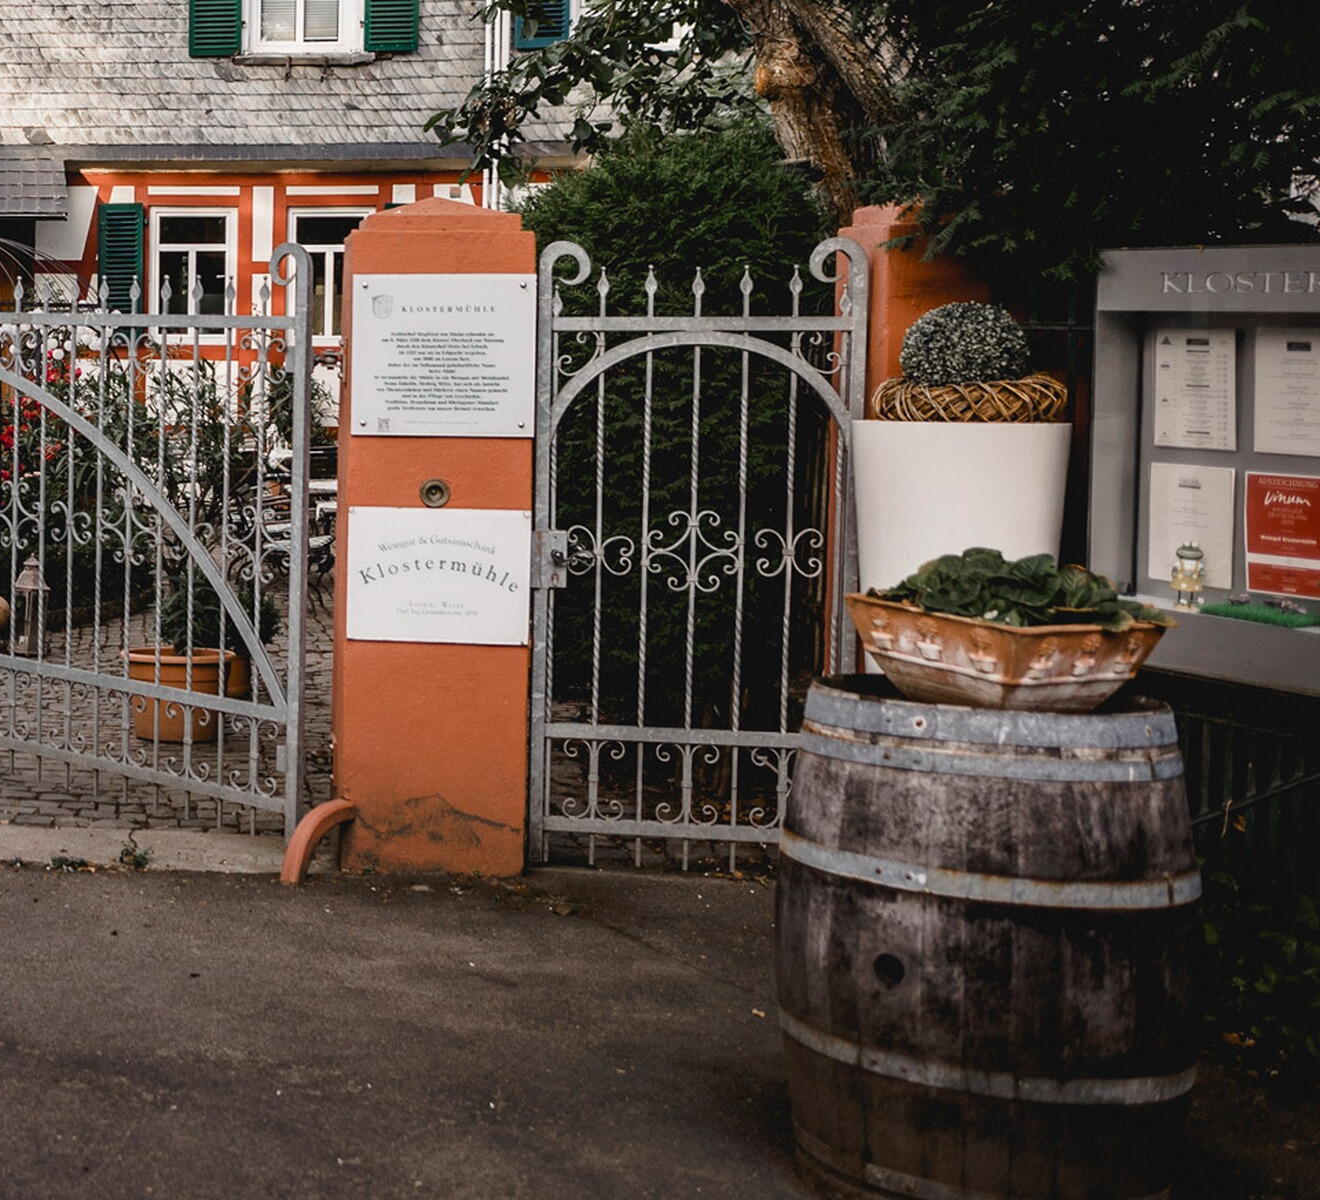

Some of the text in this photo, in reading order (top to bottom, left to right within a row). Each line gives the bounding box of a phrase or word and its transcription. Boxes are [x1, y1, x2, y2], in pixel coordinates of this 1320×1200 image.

[401, 305, 496, 313] KLOSTERMÜHLE
[1258, 478, 1319, 489] AUSZEICHNUNG
[1264, 490, 1312, 507] vinum
[377, 535, 496, 555] Weingut & Gutsausschank
[358, 559, 519, 593] Klostermühle
